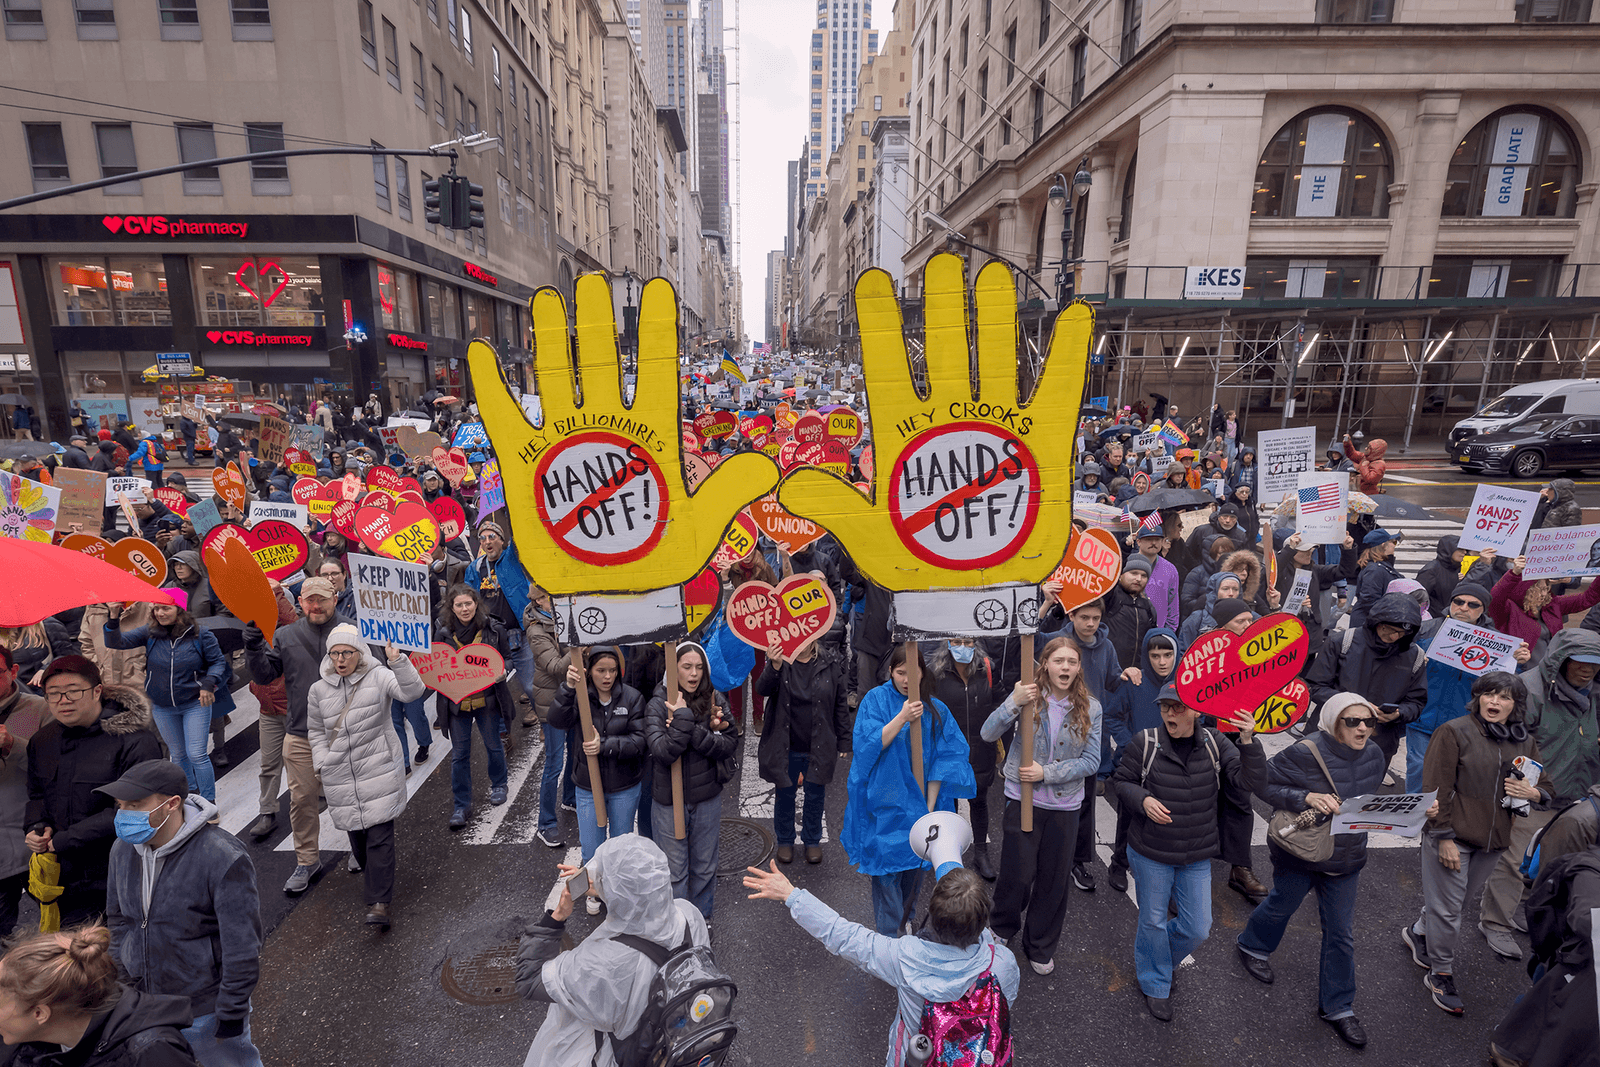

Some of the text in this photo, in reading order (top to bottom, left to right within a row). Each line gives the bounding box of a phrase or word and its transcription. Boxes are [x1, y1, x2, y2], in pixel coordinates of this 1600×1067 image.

[1498, 127, 1524, 204] GRADUATE
[1311, 175, 1326, 202] THE
[124, 216, 248, 238] CVS pharmacy
[113, 278, 134, 289] pharm
[222, 331, 312, 346] CVS pharmacy
[183, 403, 198, 418] Join
[264, 417, 287, 434] HANDS
[695, 415, 714, 427] HANDS
[702, 422, 733, 436] GREENLAND
[832, 418, 856, 430] OUR
[896, 408, 936, 438] HEY
[261, 428, 286, 445] OFF
[518, 413, 665, 464] HEY BILLIONAIRES
[799, 424, 822, 436] HANDS
[1162, 426, 1183, 442] RESIST
[270, 442, 282, 452] OUR
[796, 444, 821, 461] HANDS
[829, 446, 845, 455] OUR
[703, 454, 720, 464] ANDS
[1270, 454, 1306, 463] HANDS
[292, 463, 315, 474] MEDICARE
[541, 444, 648, 508] HANDS
[902, 438, 1023, 499] HANDS
[1271, 461, 1307, 474] OFF!
[376, 469, 403, 486] HANDS
[378, 478, 396, 490] OFF!
[113, 483, 139, 492] OFF!
[157, 490, 183, 502] HANDS
[225, 488, 243, 500] SOIL
[295, 483, 318, 494] HANDS
[301, 490, 317, 499] OFF!
[326, 489, 343, 500] OU
[369, 494, 388, 508] ANDS
[1496, 495, 1527, 503] Medicare
[1, 506, 27, 522] HANDS
[254, 508, 296, 518] CONSTITUTION
[333, 500, 356, 518] HANDS
[434, 504, 458, 517] OUR
[576, 480, 652, 540] OFF!
[934, 484, 1024, 543] OFF!
[1476, 504, 1522, 521] HANDS
[336, 511, 355, 526] OFF!
[362, 513, 390, 536] HANDS
[767, 517, 816, 535] UNIONS
[2, 523, 20, 535] OFF
[257, 525, 293, 543] OUR
[374, 524, 392, 541] OFF!
[1476, 518, 1519, 537] OFF!!
[1532, 530, 1596, 542] The balance
[394, 525, 428, 548] OUR
[727, 528, 749, 552] UR
[253, 543, 294, 563] ETERANS
[395, 536, 435, 562] VOTES
[1079, 538, 1115, 577] OUR
[1530, 544, 1564, 554] power
[133, 554, 157, 576] OUR
[260, 553, 296, 570] ENEFITS
[1526, 552, 1590, 564] the scale of
[358, 564, 390, 588] KEEP
[1524, 565, 1559, 576] peace.
[395, 568, 428, 593] YOUR
[359, 589, 429, 616] KLEPTOCRACY
[730, 592, 779, 619] HANDS
[789, 588, 823, 611] OUR
[369, 610, 384, 618] OUT
[744, 606, 781, 630] OFF!
[360, 618, 429, 649] DEMOCRACY
[766, 614, 820, 645] BOOKS
[1473, 629, 1495, 640] STILL
[1246, 627, 1288, 657] OUR
[1447, 628, 1464, 640] NOT
[1464, 633, 1475, 643] MY
[1473, 637, 1512, 654] PRESIDENT
[412, 650, 449, 668] HANDS
[1184, 633, 1231, 669] HANDS
[1454, 646, 1498, 666] 45/47
[419, 656, 457, 674] OFF!
[465, 655, 490, 667] OUR
[1180, 652, 1225, 685] OFF!
[438, 668, 495, 683] MUSEUMS
[1196, 649, 1297, 703] CONSTITUTION
[1254, 698, 1297, 729] OKS
[1361, 803, 1418, 814] OFF!
